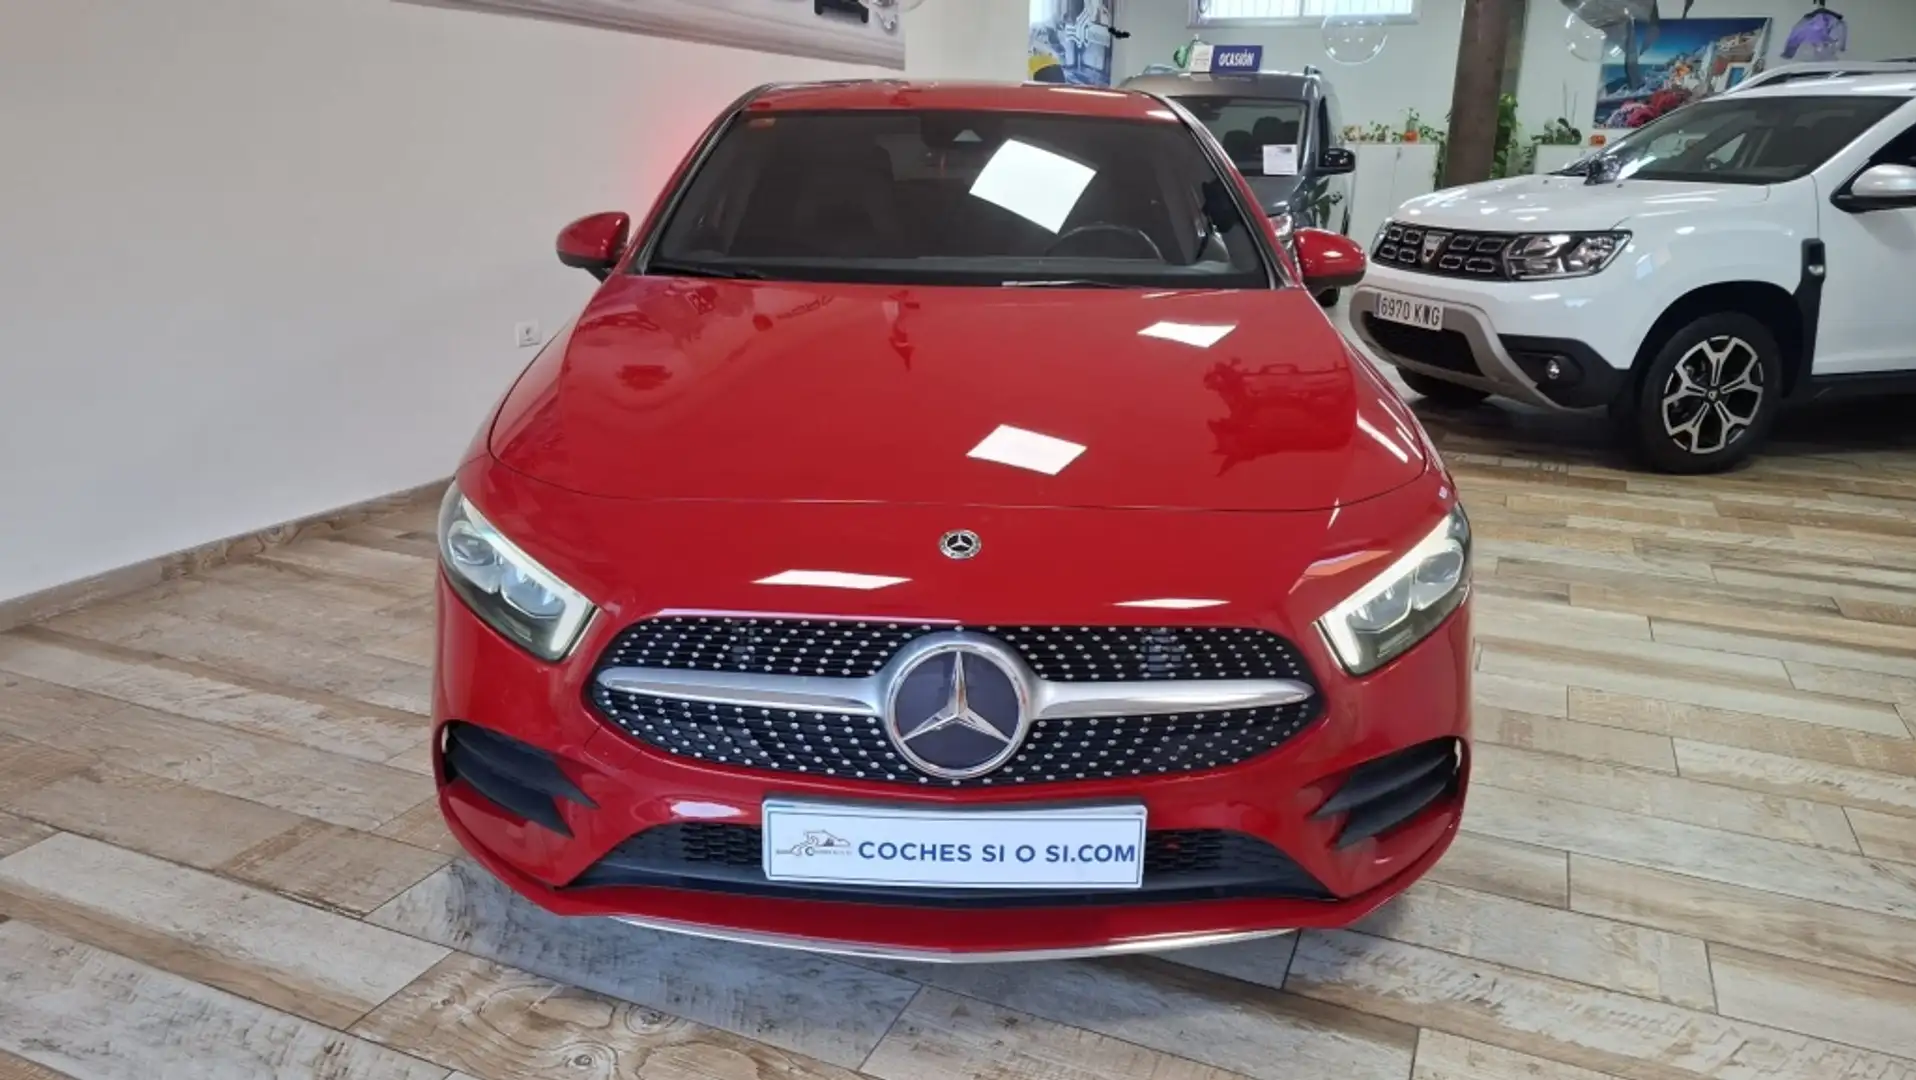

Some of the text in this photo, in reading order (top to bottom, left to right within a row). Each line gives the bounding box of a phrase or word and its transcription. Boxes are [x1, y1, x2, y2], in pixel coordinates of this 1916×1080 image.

[1218, 48, 1254, 67] OCASIÓN
[1381, 297, 1410, 320] 6970
[858, 841, 972, 863] COCHES
[982, 844, 1005, 863] SI
[1015, 844, 1036, 863] O
[1045, 844, 1136, 863] SI.COM
